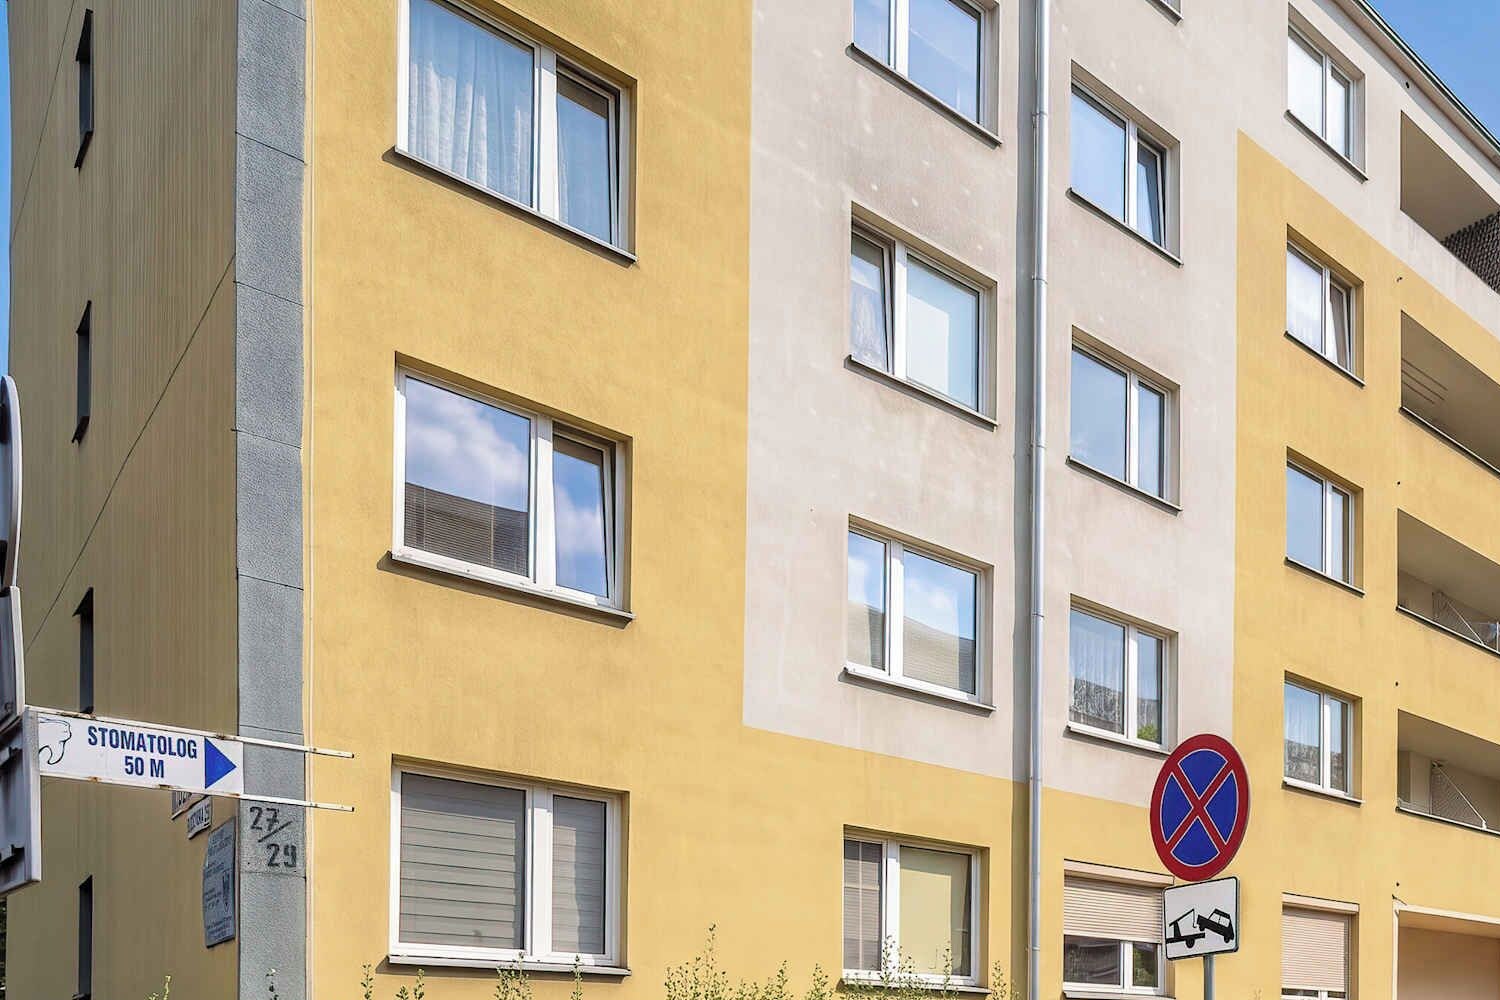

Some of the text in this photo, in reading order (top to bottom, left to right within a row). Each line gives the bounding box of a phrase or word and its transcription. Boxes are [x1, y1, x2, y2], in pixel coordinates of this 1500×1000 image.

[88, 726, 197, 759] STOMATOLOG
[124, 755, 165, 778] 50 M
[266, 843, 297, 868] 29
